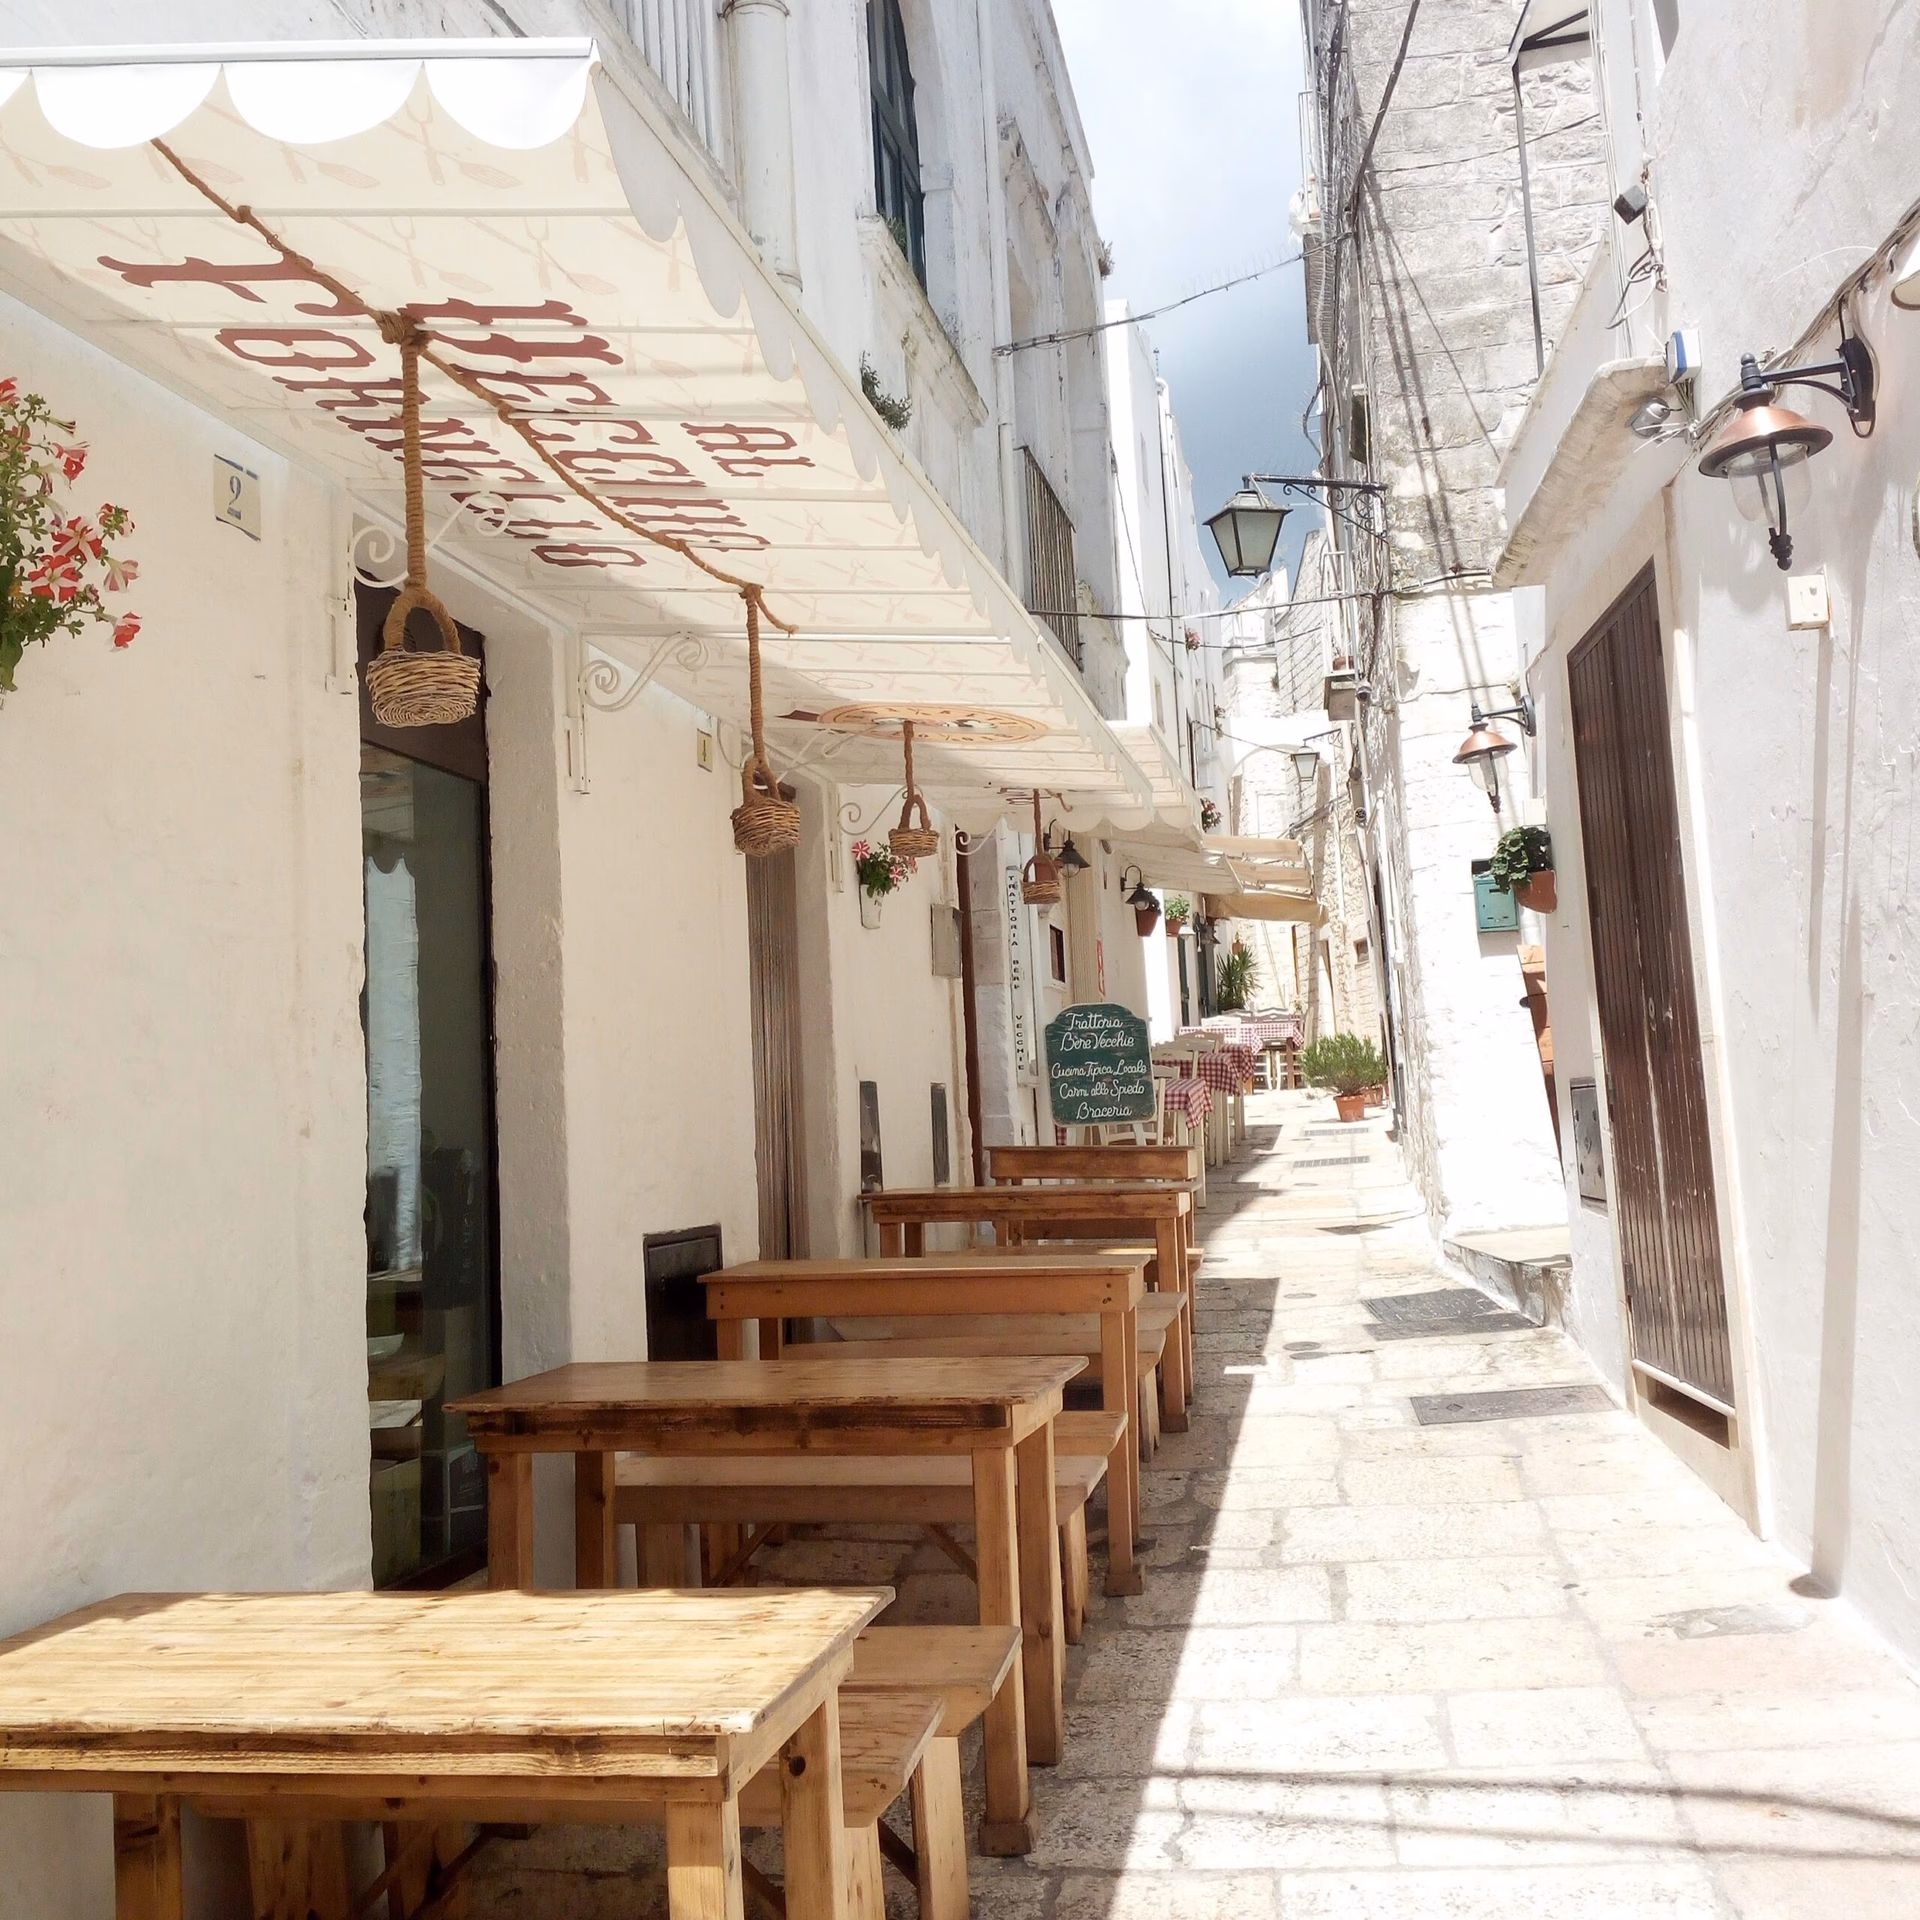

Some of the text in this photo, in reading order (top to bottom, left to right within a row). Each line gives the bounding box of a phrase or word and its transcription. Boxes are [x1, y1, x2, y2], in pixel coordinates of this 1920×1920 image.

[680, 423, 816, 477] AL
[226, 475, 242, 520] 2
[1008, 875, 1019, 946] TRATTORIA
[1015, 1014, 1025, 1071] VECCHIE
[1065, 1012, 1124, 1032] Trattoria
[1091, 1029, 1135, 1050] Vecchie
[1051, 1059, 1147, 1081] Cucina Tipica Locale
[1059, 1083, 1089, 1099] Carni
[1110, 1079, 1145, 1102] Spiedo
[1076, 1101, 1133, 1120] Braceria
